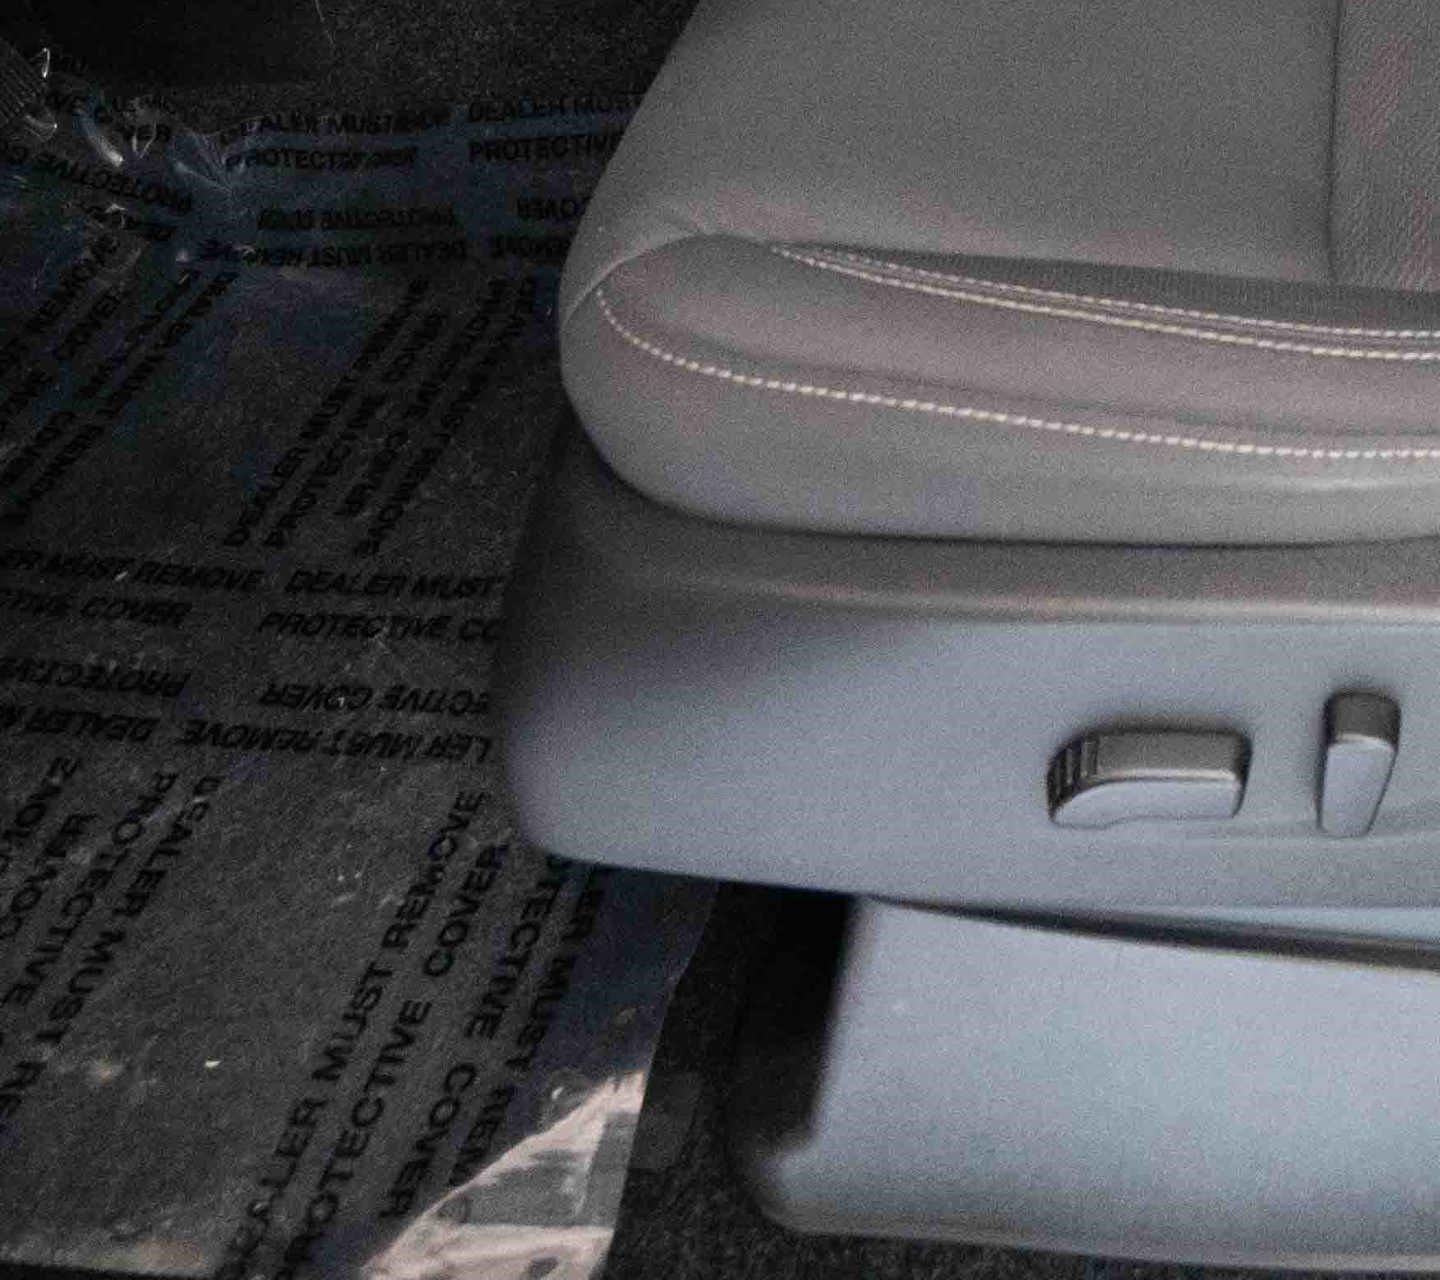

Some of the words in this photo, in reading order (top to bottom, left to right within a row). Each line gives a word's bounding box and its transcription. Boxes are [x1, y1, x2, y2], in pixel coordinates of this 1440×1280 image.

[133, 559, 266, 593] REMOVE
[285, 569, 409, 597] DEALER
[410, 575, 506, 600] MUST
[80, 596, 193, 629] COVER
[257, 611, 452, 639] PROTECTIVE
[258, 681, 375, 712] COVER
[22, 707, 163, 743] DEALER
[175, 718, 323, 752] REMOVE
[319, 727, 423, 761] MUST
[423, 732, 492, 763] LER
[112, 776, 222, 920] DEALER
[0, 771, 179, 1007] PROTECTIVE
[421, 840, 514, 980] COVER
[312, 960, 397, 1083] MUST
[380, 790, 489, 951] REMOVE
[35, 929, 127, 1045] MUST
[503, 952, 578, 1072] MUST
[378, 1061, 478, 1220] COVER
